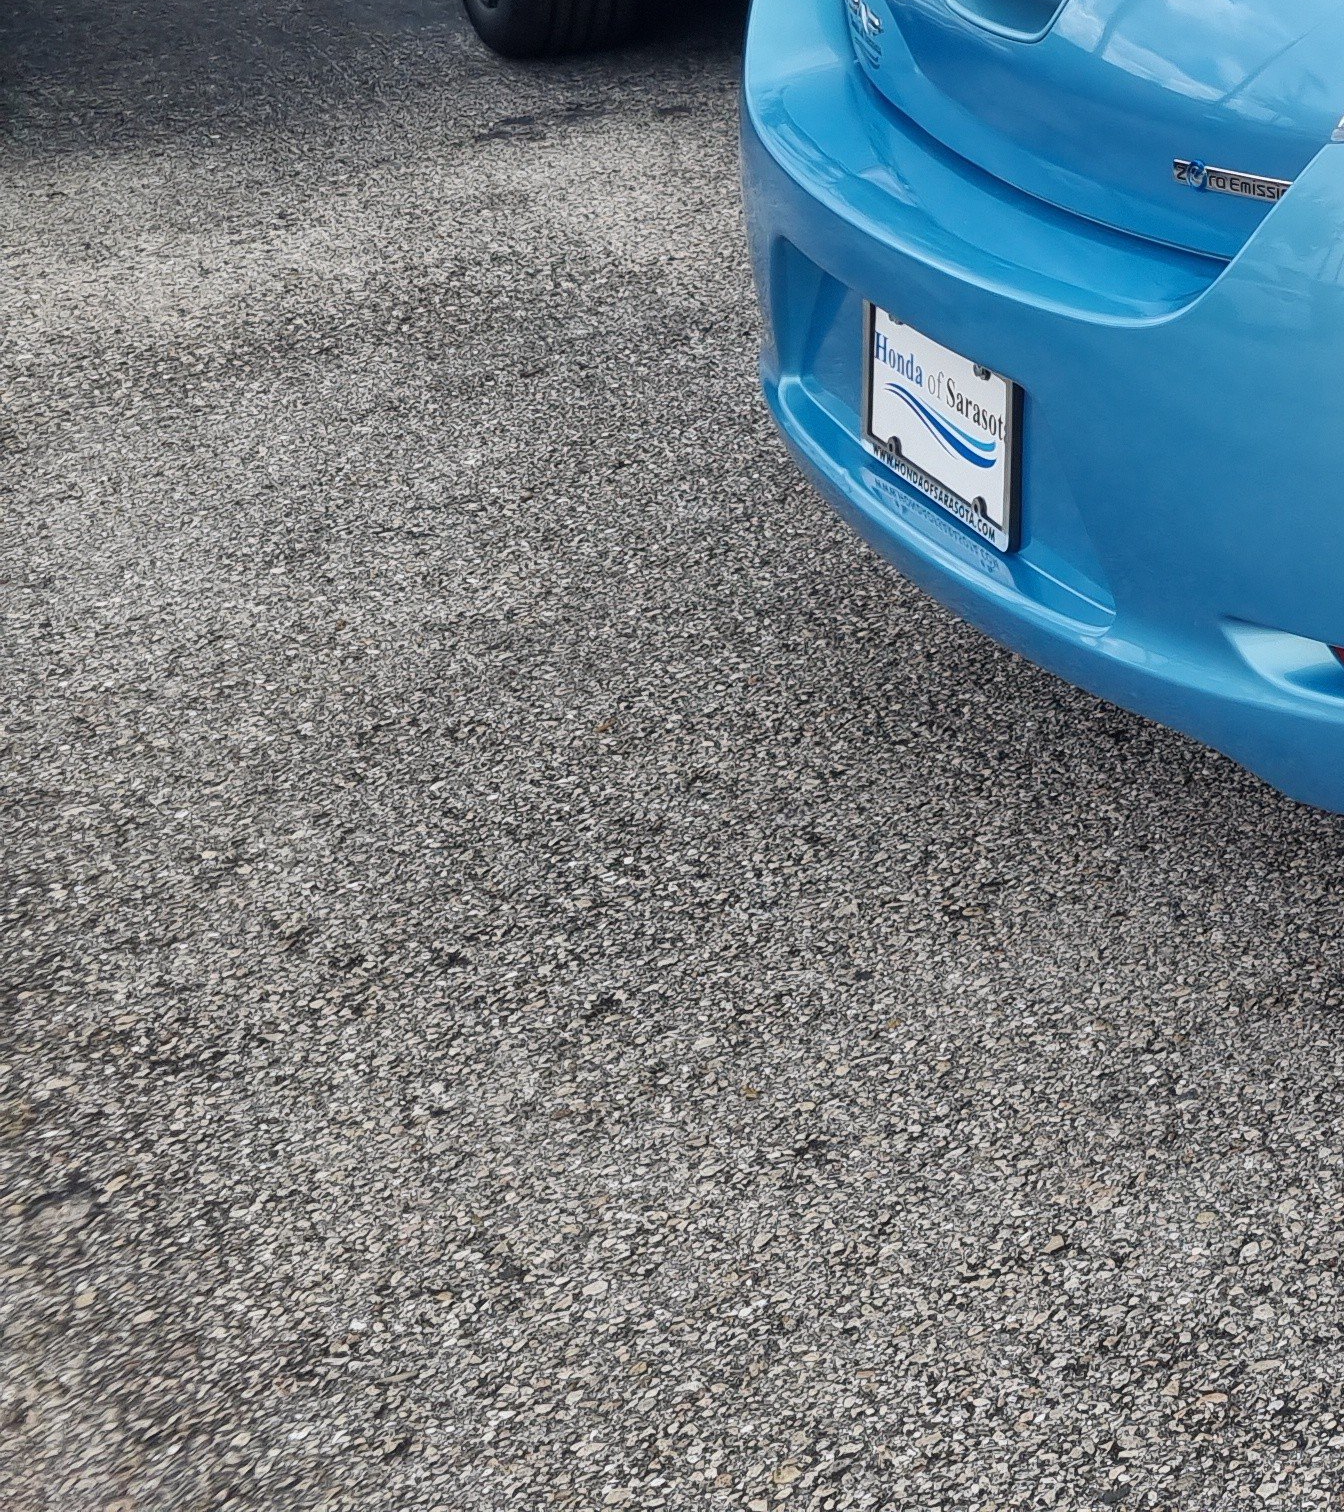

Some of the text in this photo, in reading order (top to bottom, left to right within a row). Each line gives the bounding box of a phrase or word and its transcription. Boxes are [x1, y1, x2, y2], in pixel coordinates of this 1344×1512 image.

[1229, 177, 1288, 200] Emissi
[874, 332, 1006, 441] Honda of Sarasot
[873, 444, 996, 543] WWW.HONDAOFSARASOTA.COM
